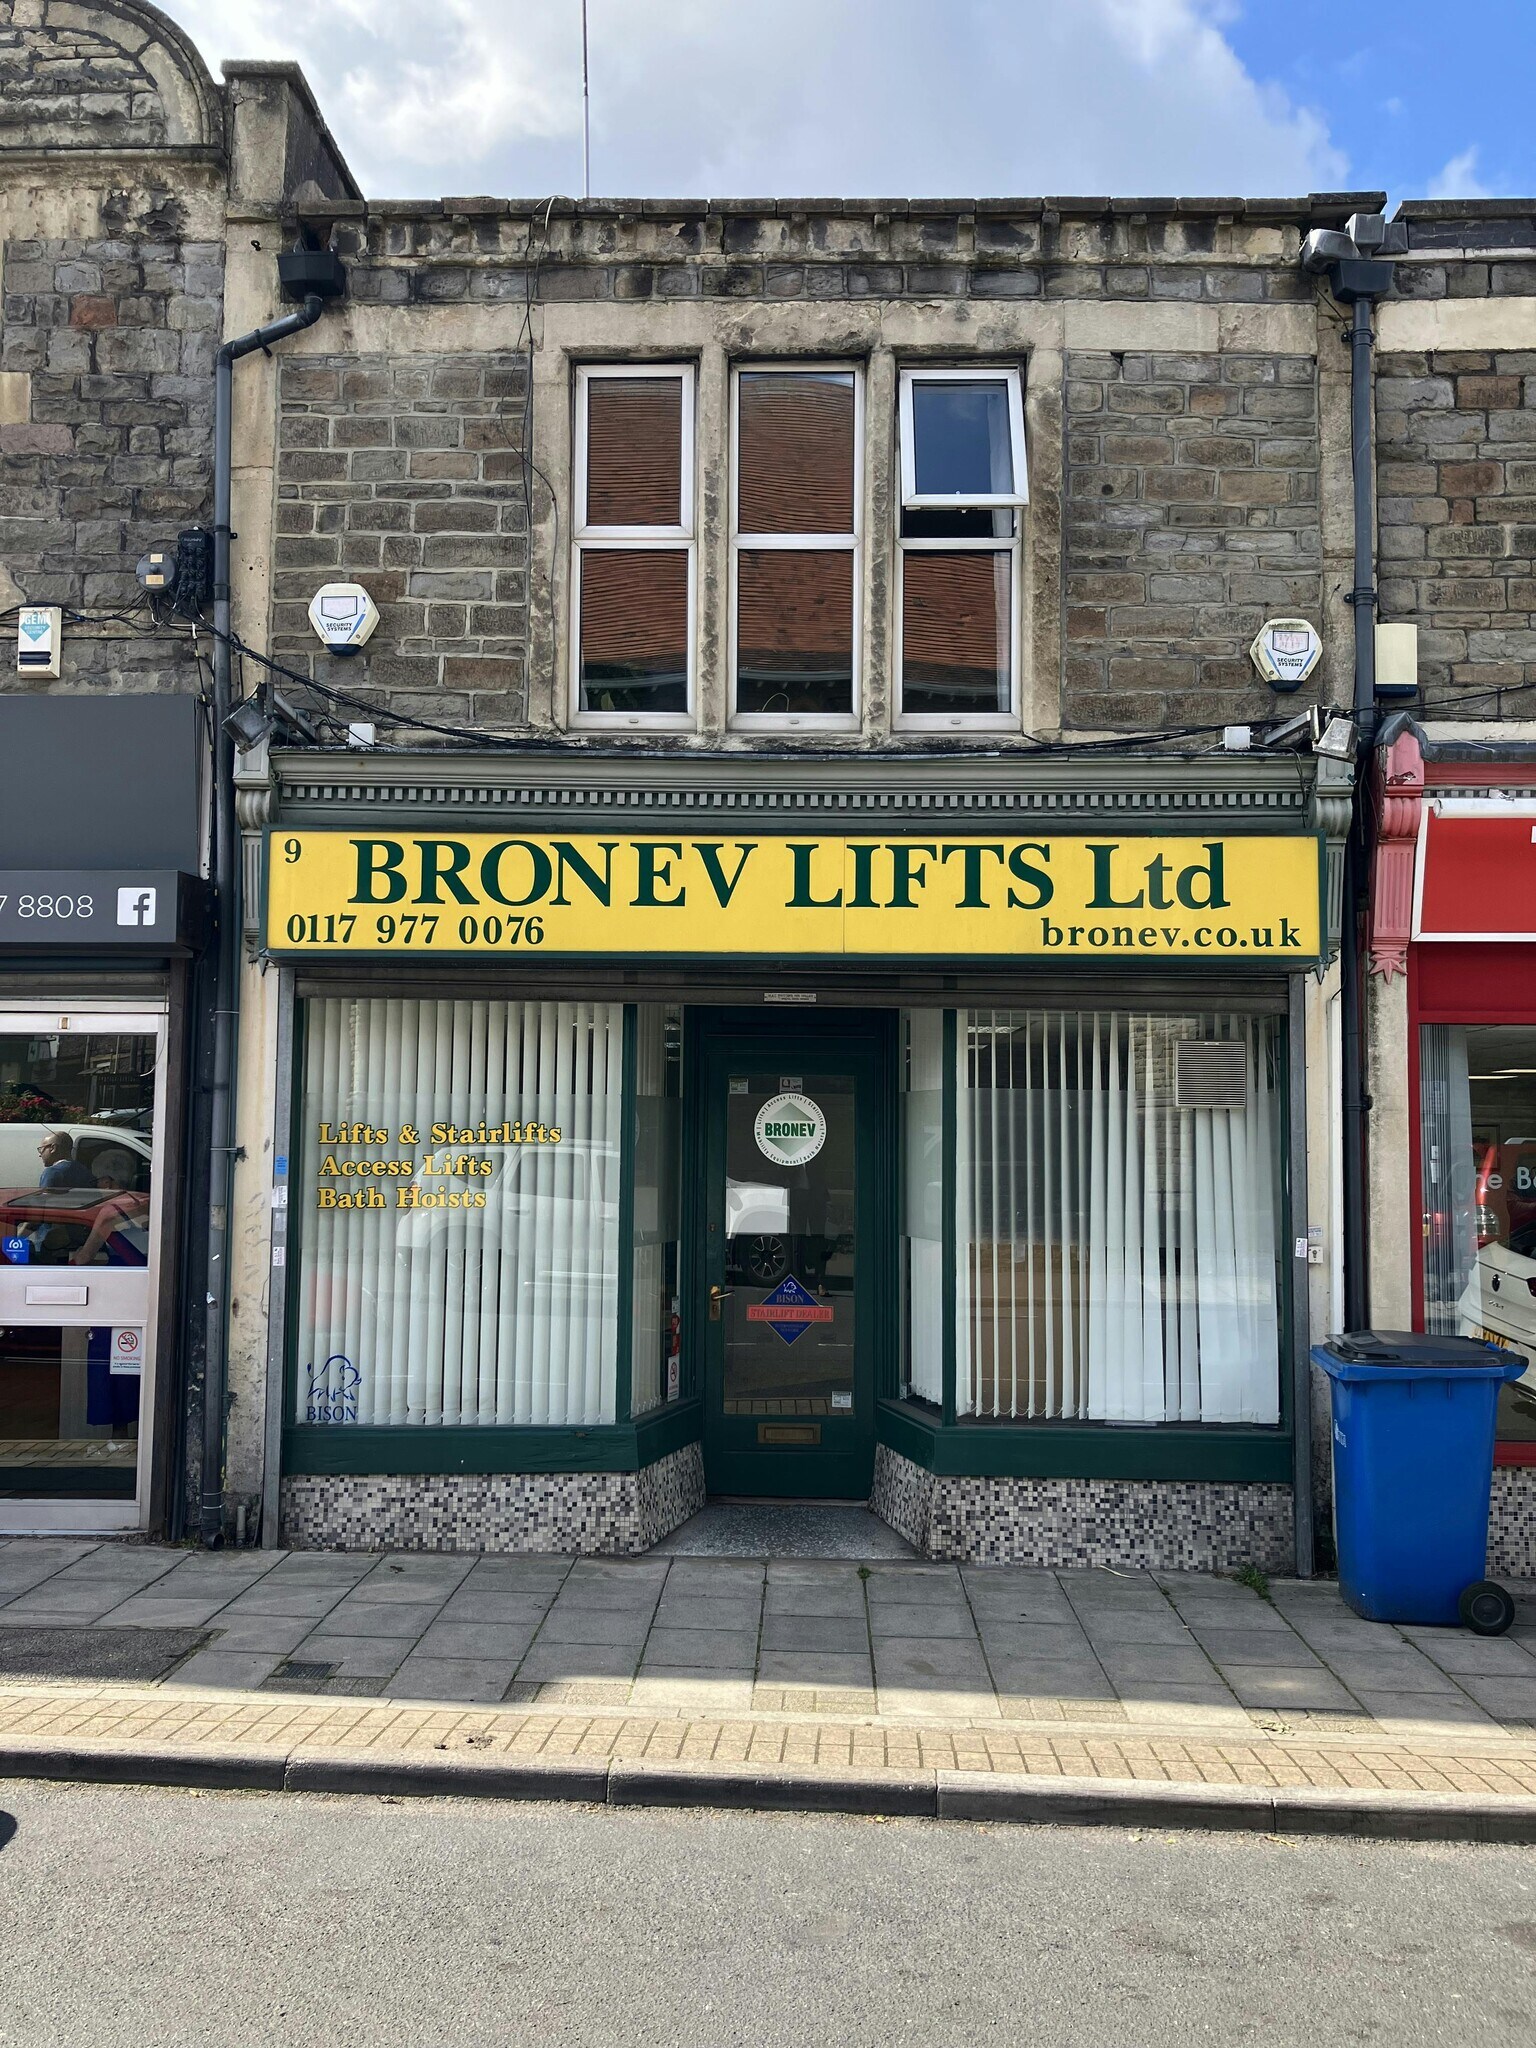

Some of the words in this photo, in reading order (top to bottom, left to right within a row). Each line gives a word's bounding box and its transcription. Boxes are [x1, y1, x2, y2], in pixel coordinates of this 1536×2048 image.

[24, 614, 46, 625] GEM
[284, 838, 302, 863] 9
[347, 839, 758, 909] BRONEV
[785, 842, 1054, 910] LIFTS
[1085, 842, 1231, 910] Ltd
[18, 895, 93, 918] 8808
[286, 913, 357, 944] 0117
[376, 913, 439, 944] 977
[458, 913, 545, 945] 0076
[1040, 917, 1302, 948] bronev.co.uk
[318, 1122, 389, 1145] Lifts
[397, 1123, 420, 1145] &
[430, 1121, 562, 1145] Stairlifts
[764, 1122, 816, 1137] BRONEV
[318, 1155, 413, 1177] Access
[423, 1154, 494, 1177] Lifts
[317, 1186, 387, 1210] Bath
[396, 1185, 488, 1209] Hoists
[776, 1294, 804, 1304] BISON
[750, 1308, 795, 1318] STAIRLIFT
[796, 1309, 831, 1319] DEALER
[306, 1405, 358, 1421] BISON
